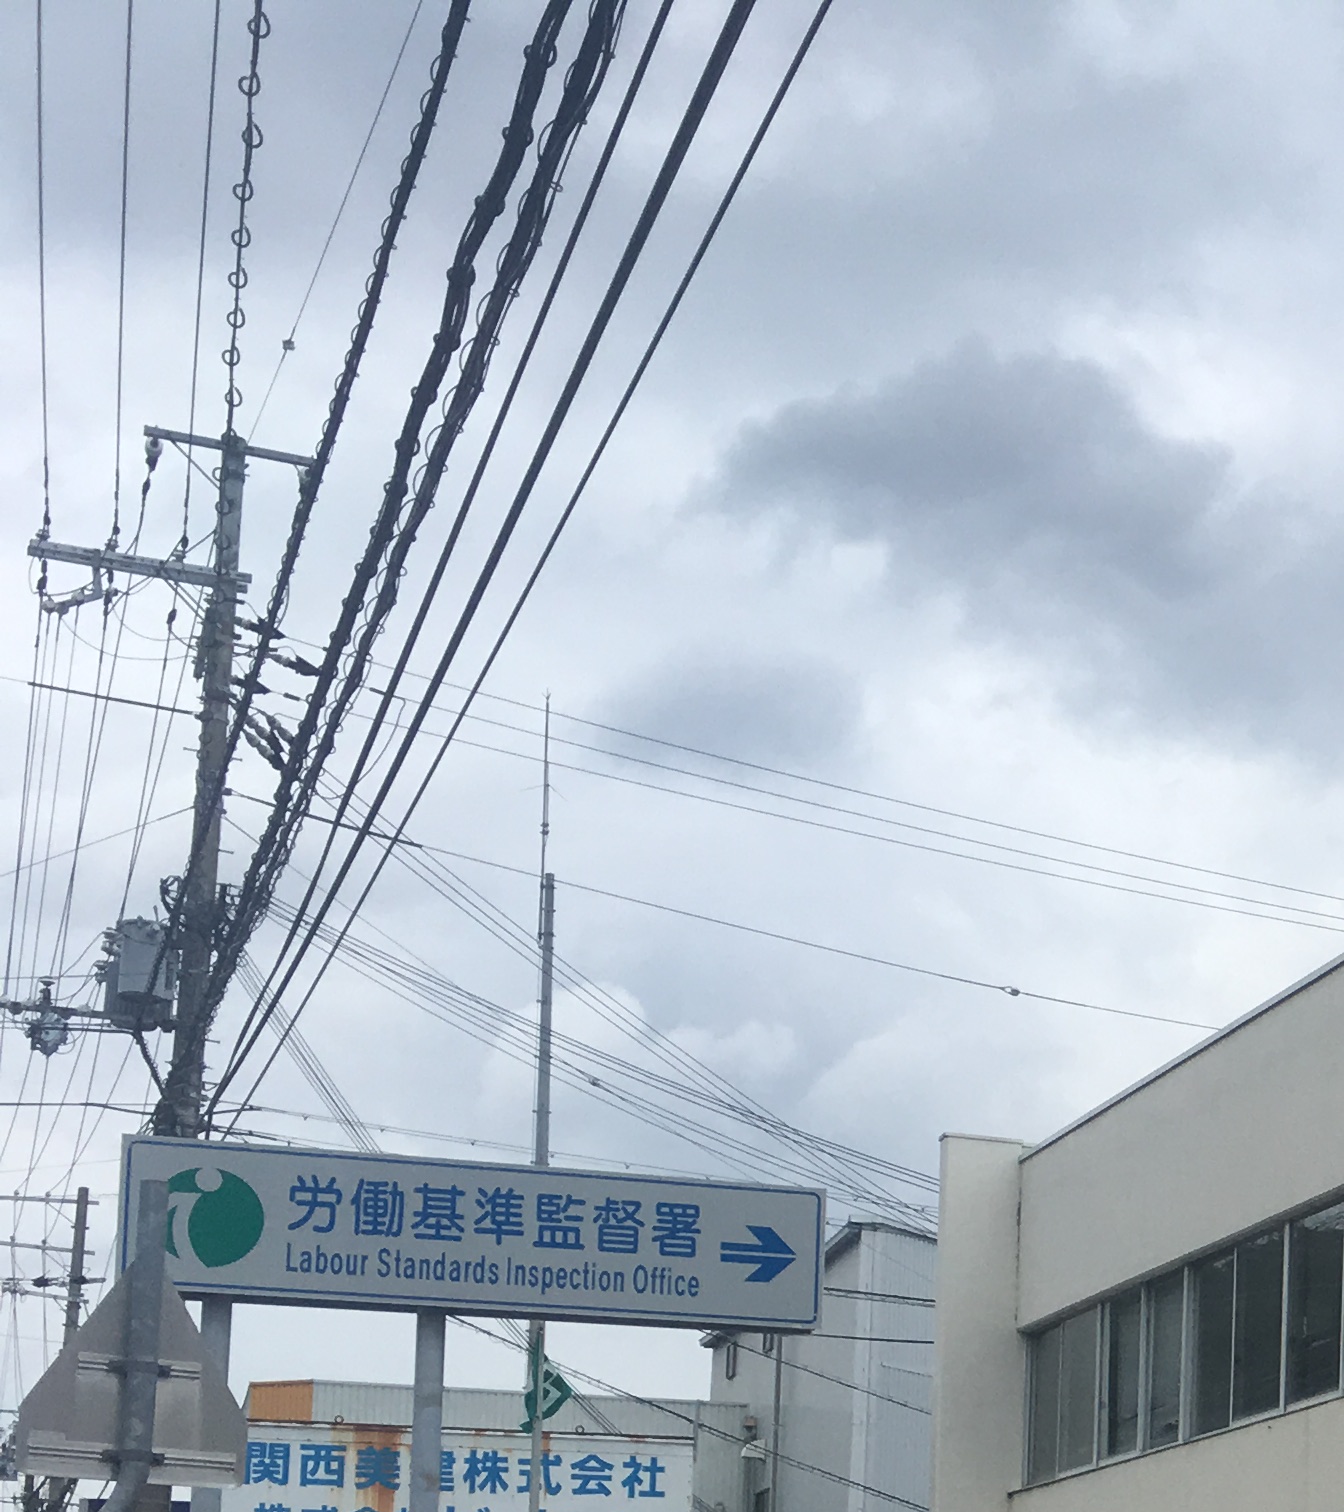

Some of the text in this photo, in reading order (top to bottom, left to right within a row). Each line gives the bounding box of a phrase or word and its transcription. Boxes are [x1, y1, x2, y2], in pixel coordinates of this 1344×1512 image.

[287, 1174, 702, 1259] 労働基準監督署
[285, 1242, 701, 1298] Labour Standards Inspection Office
